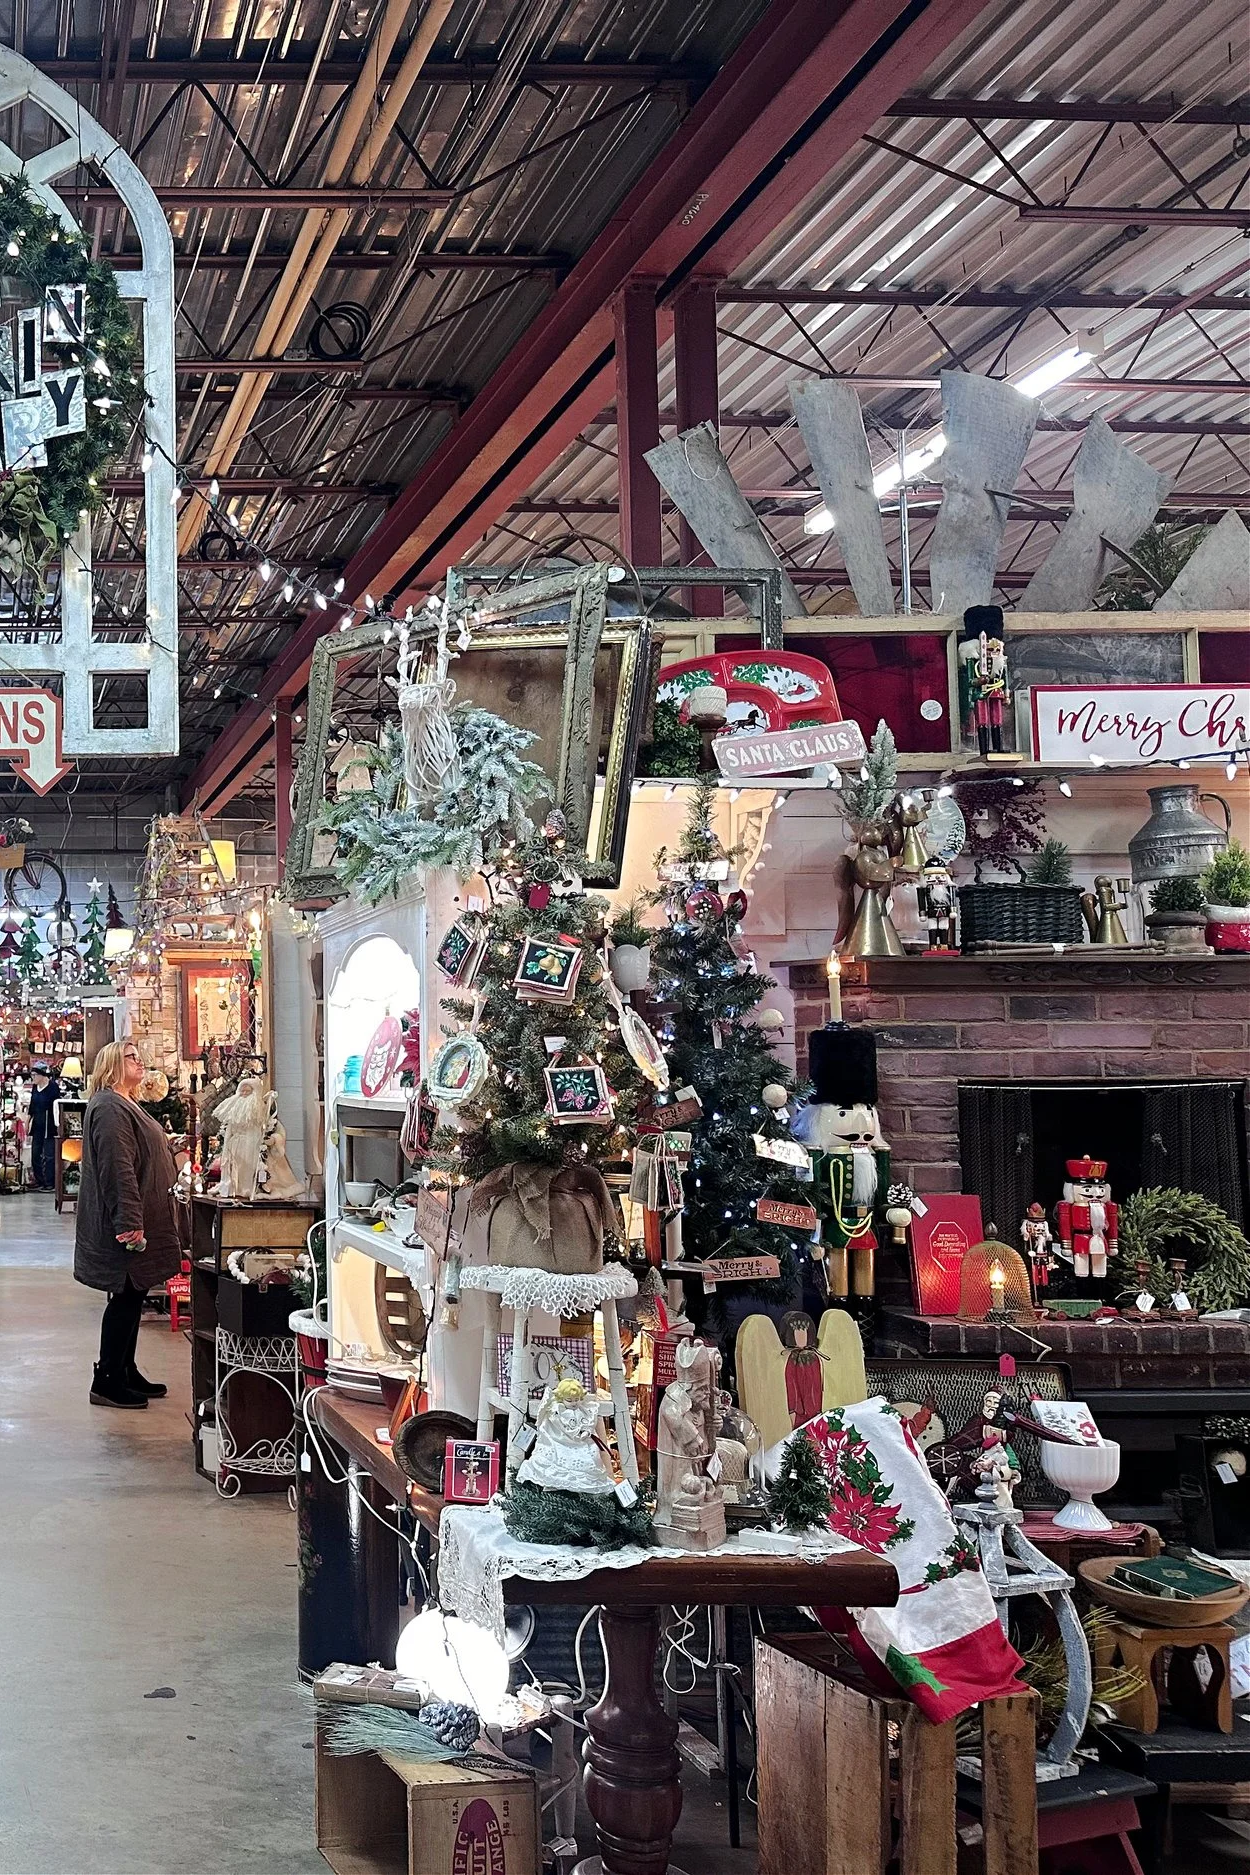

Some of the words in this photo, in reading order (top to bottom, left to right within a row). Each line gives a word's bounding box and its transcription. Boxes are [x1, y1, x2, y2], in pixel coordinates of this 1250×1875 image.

[1057, 700, 1172, 757] Merry
[725, 743, 786, 768] SANTA
[789, 731, 851, 760] CLAUS
[718, 1260, 754, 1271] Merry
